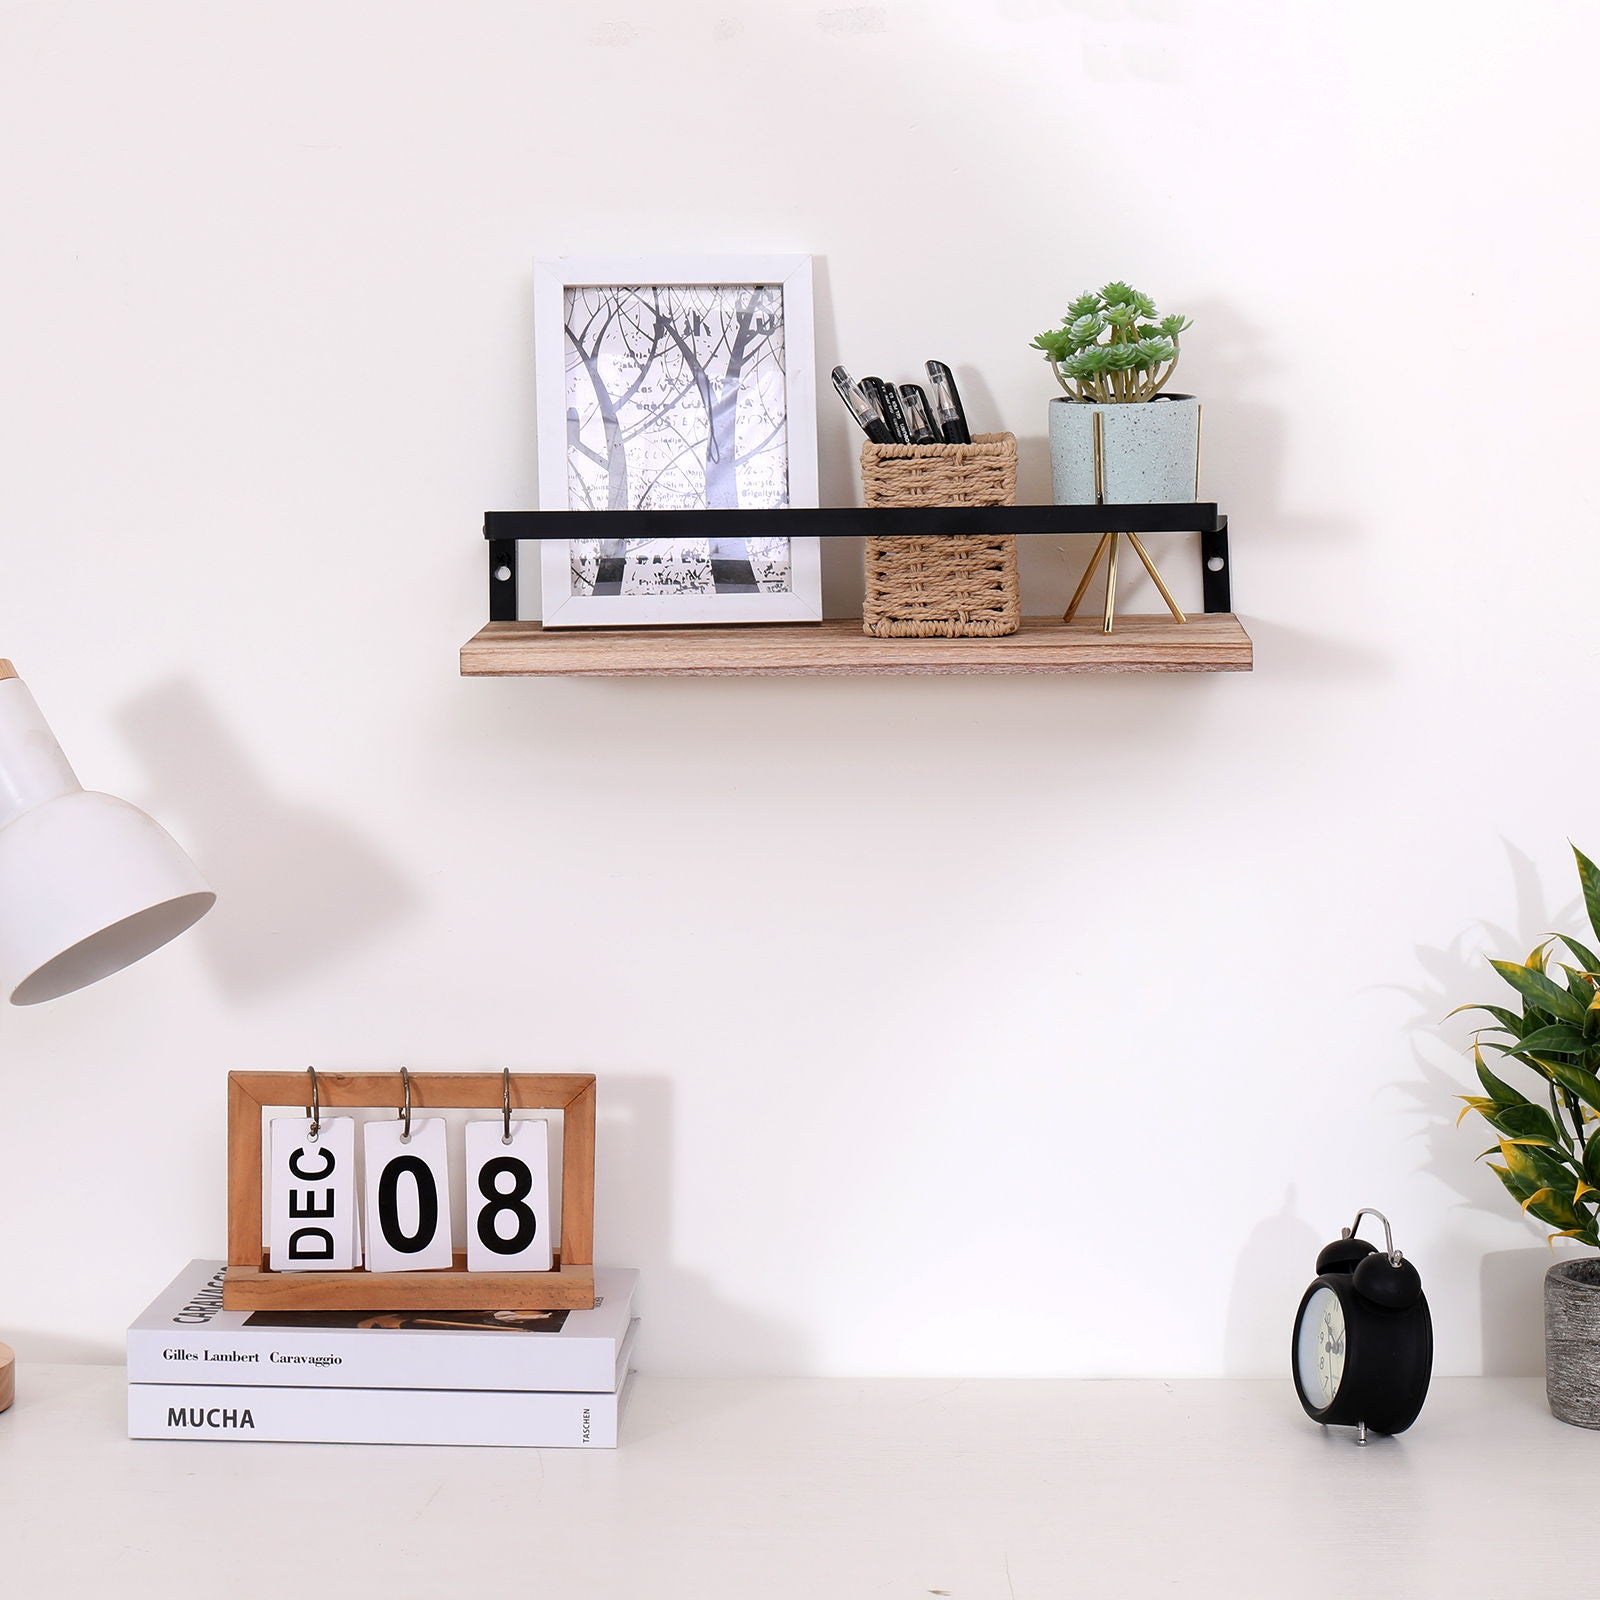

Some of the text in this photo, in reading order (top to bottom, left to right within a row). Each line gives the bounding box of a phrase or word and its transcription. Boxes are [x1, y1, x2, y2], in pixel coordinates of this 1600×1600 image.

[288, 1146, 337, 1260] DEC
[162, 1349, 343, 1368] Gilles Lambert Caravaggio
[167, 1407, 256, 1429] MUCHA
[582, 1408, 591, 1444] TASCHEN
